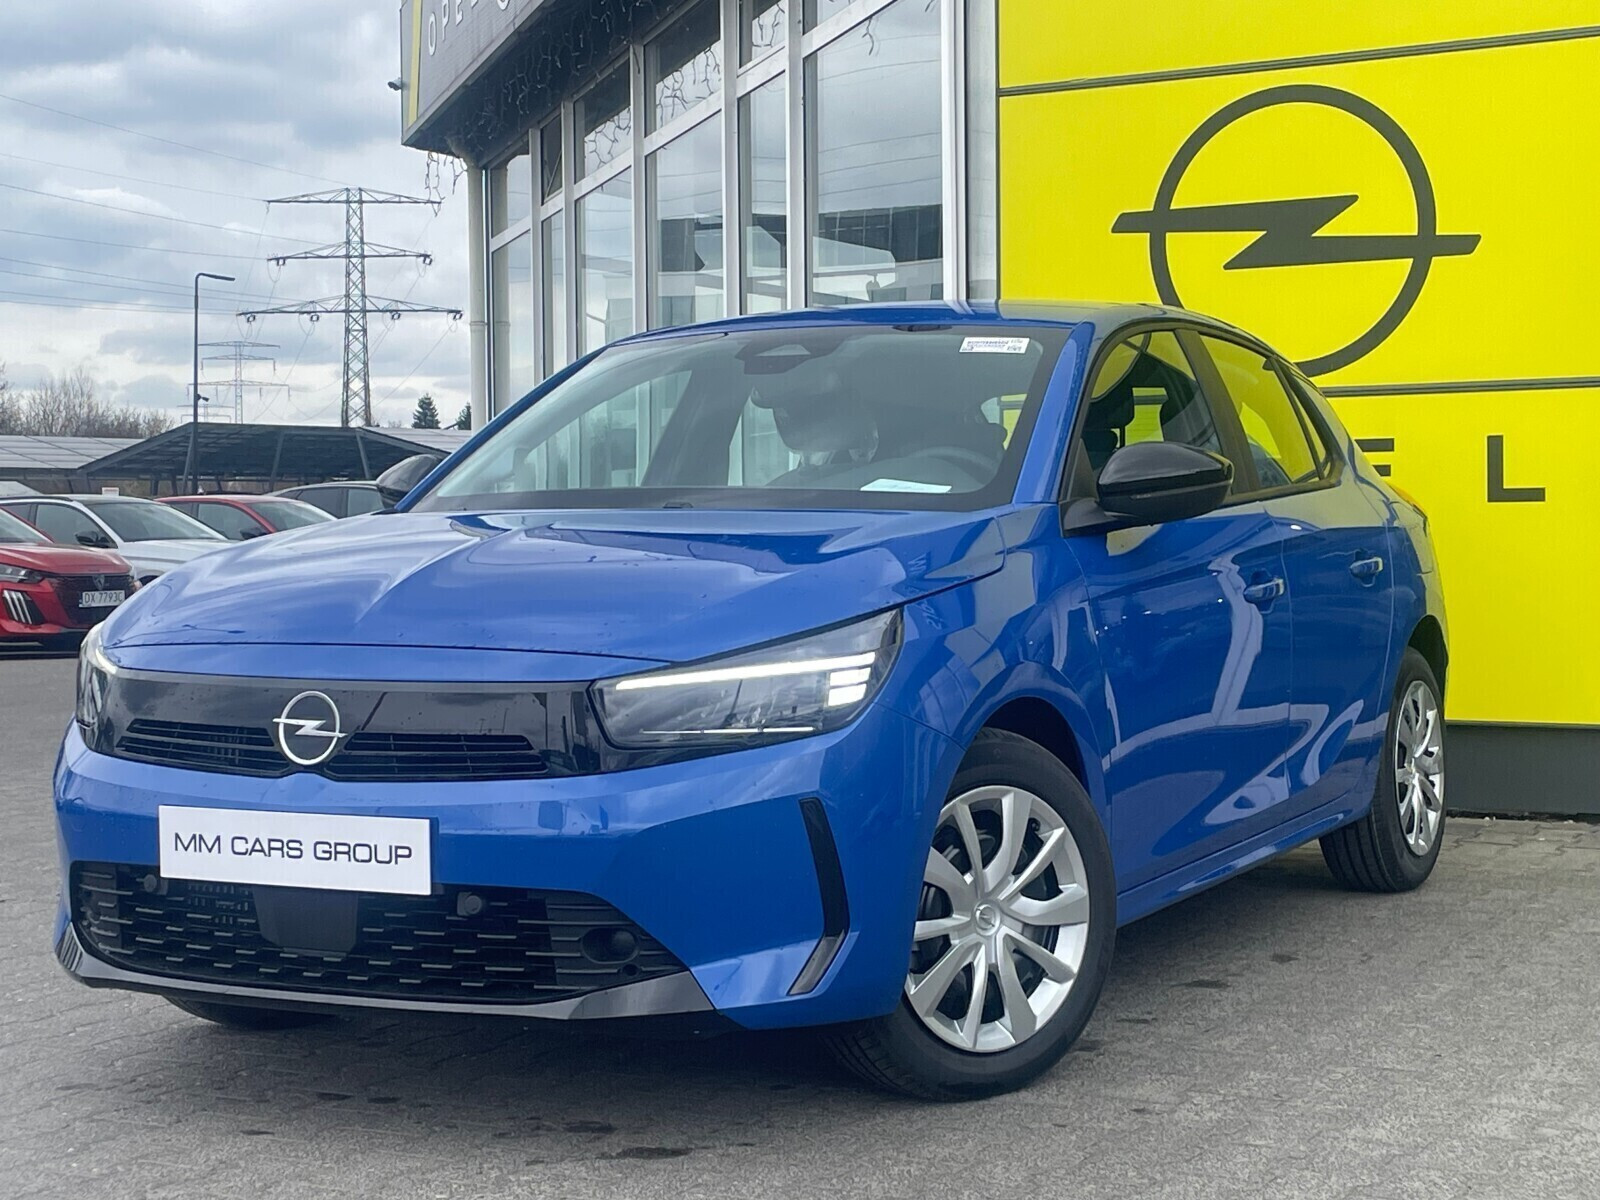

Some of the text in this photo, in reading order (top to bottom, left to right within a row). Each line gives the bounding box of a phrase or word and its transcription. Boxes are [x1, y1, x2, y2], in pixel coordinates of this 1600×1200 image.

[428, 0, 478, 56] OPE
[84, 592, 96, 604] DX
[174, 832, 412, 865] MM CARS GROUP
